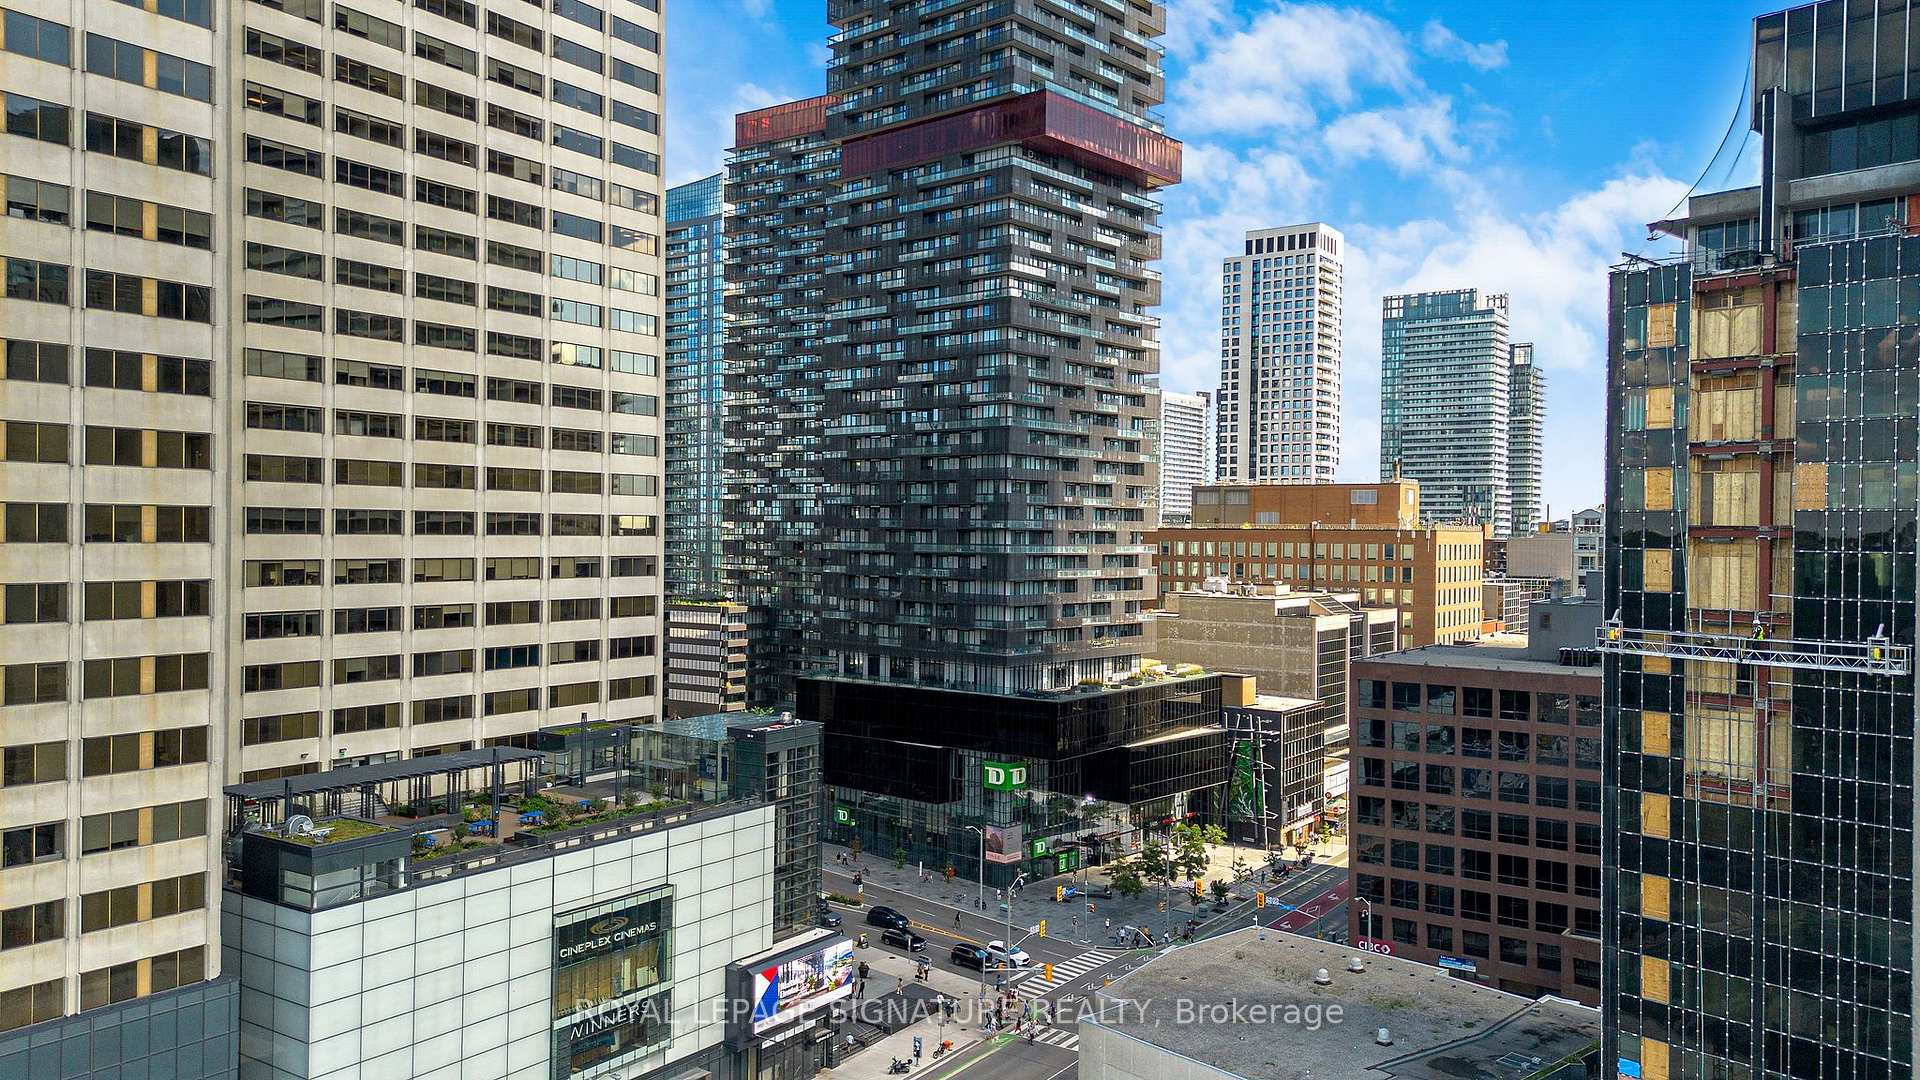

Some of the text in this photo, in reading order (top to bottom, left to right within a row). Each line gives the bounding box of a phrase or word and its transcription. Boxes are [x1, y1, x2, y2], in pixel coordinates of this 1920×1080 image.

[985, 766, 1005, 785] TD
[1009, 767, 1027, 785] TD
[837, 809, 848, 821] TD
[1035, 841, 1045, 854] TD
[560, 921, 657, 959] CINEPLEX CINEMAS
[1358, 940, 1381, 953] CIBC
